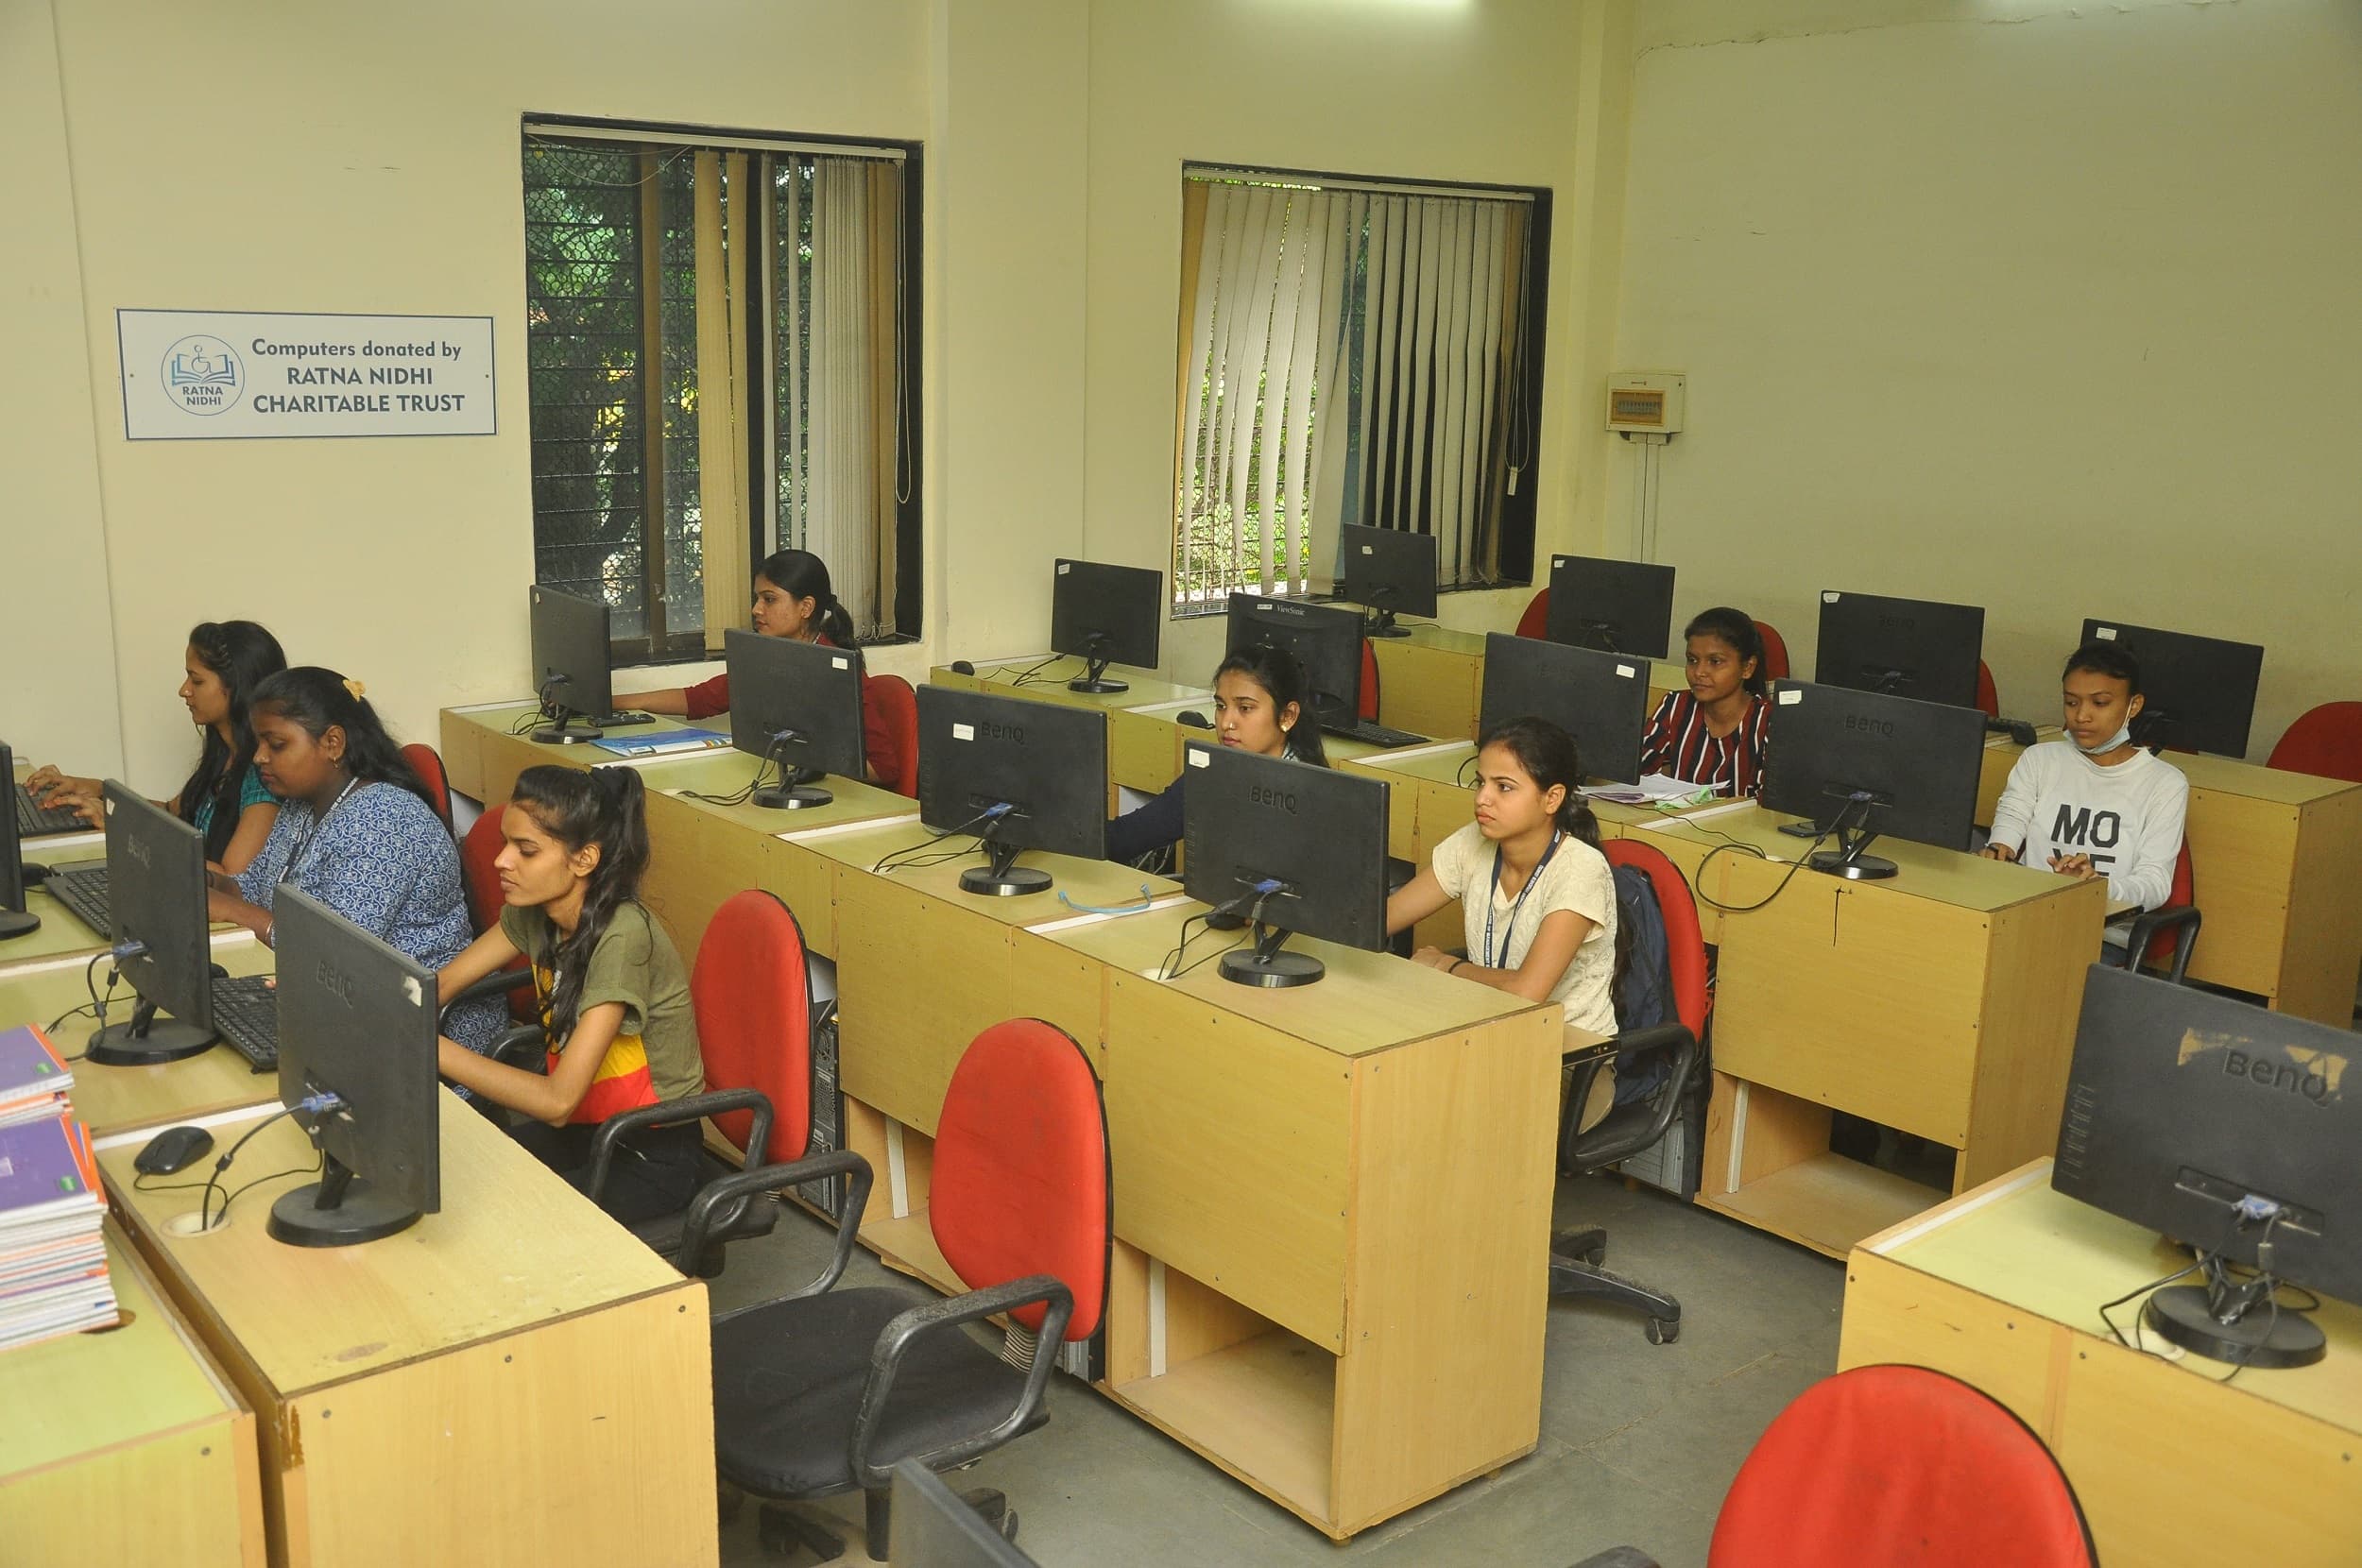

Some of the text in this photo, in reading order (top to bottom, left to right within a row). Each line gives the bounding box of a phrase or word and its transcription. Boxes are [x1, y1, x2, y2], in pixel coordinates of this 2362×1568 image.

[252, 338, 461, 361] Computers donated by
[287, 366, 433, 384] RATNA NIDHI
[182, 386, 223, 395] RATNA
[186, 397, 221, 405] NIDHI
[253, 394, 465, 413] CHARITABLE TRUST
[1276, 605, 1305, 616] ViewSonic
[981, 721, 1026, 746] BenQ
[1844, 715, 1894, 738] BenQ
[1248, 786, 1298, 815] BenQ
[2050, 804, 2120, 848] MO
[2223, 1048, 2330, 1109] BenQ
